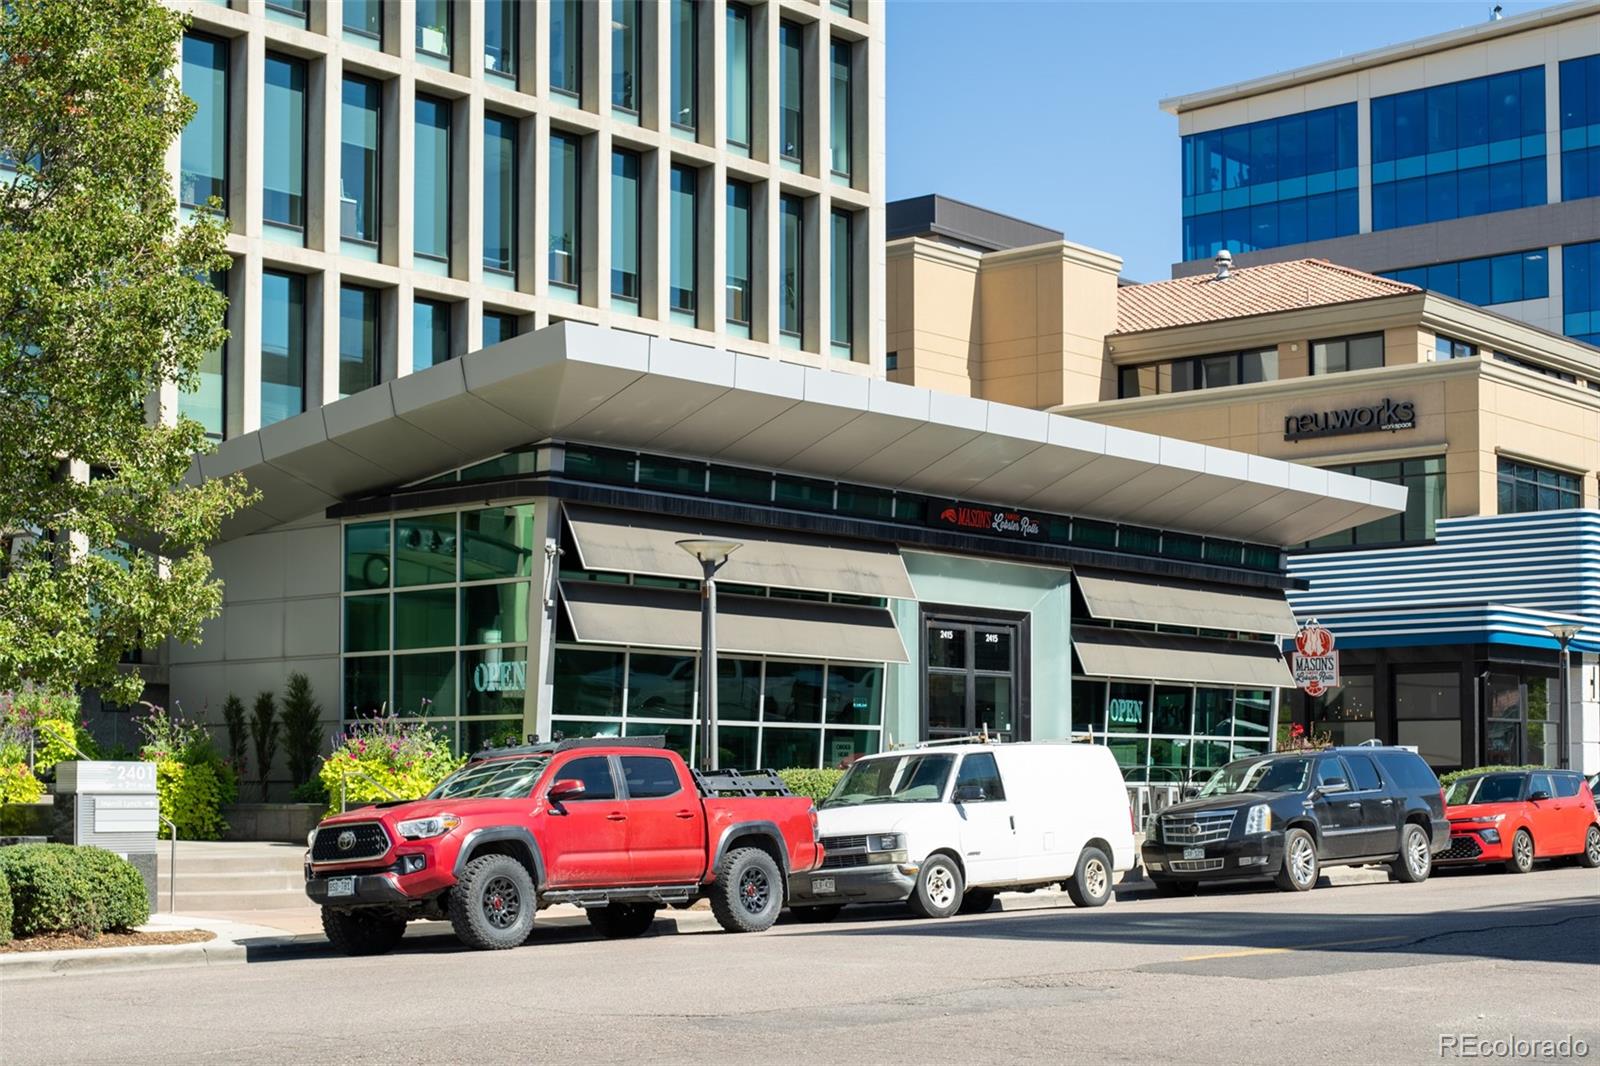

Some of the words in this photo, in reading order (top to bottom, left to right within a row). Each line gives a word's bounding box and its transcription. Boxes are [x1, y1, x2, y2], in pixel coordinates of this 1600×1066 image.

[1284, 398, 1416, 434] neu.works
[940, 630, 953, 639] 2415
[985, 634, 998, 643] 2415
[474, 661, 527, 692] OPEN
[1110, 698, 1143, 723] OPEN
[117, 766, 152, 780] 2401
